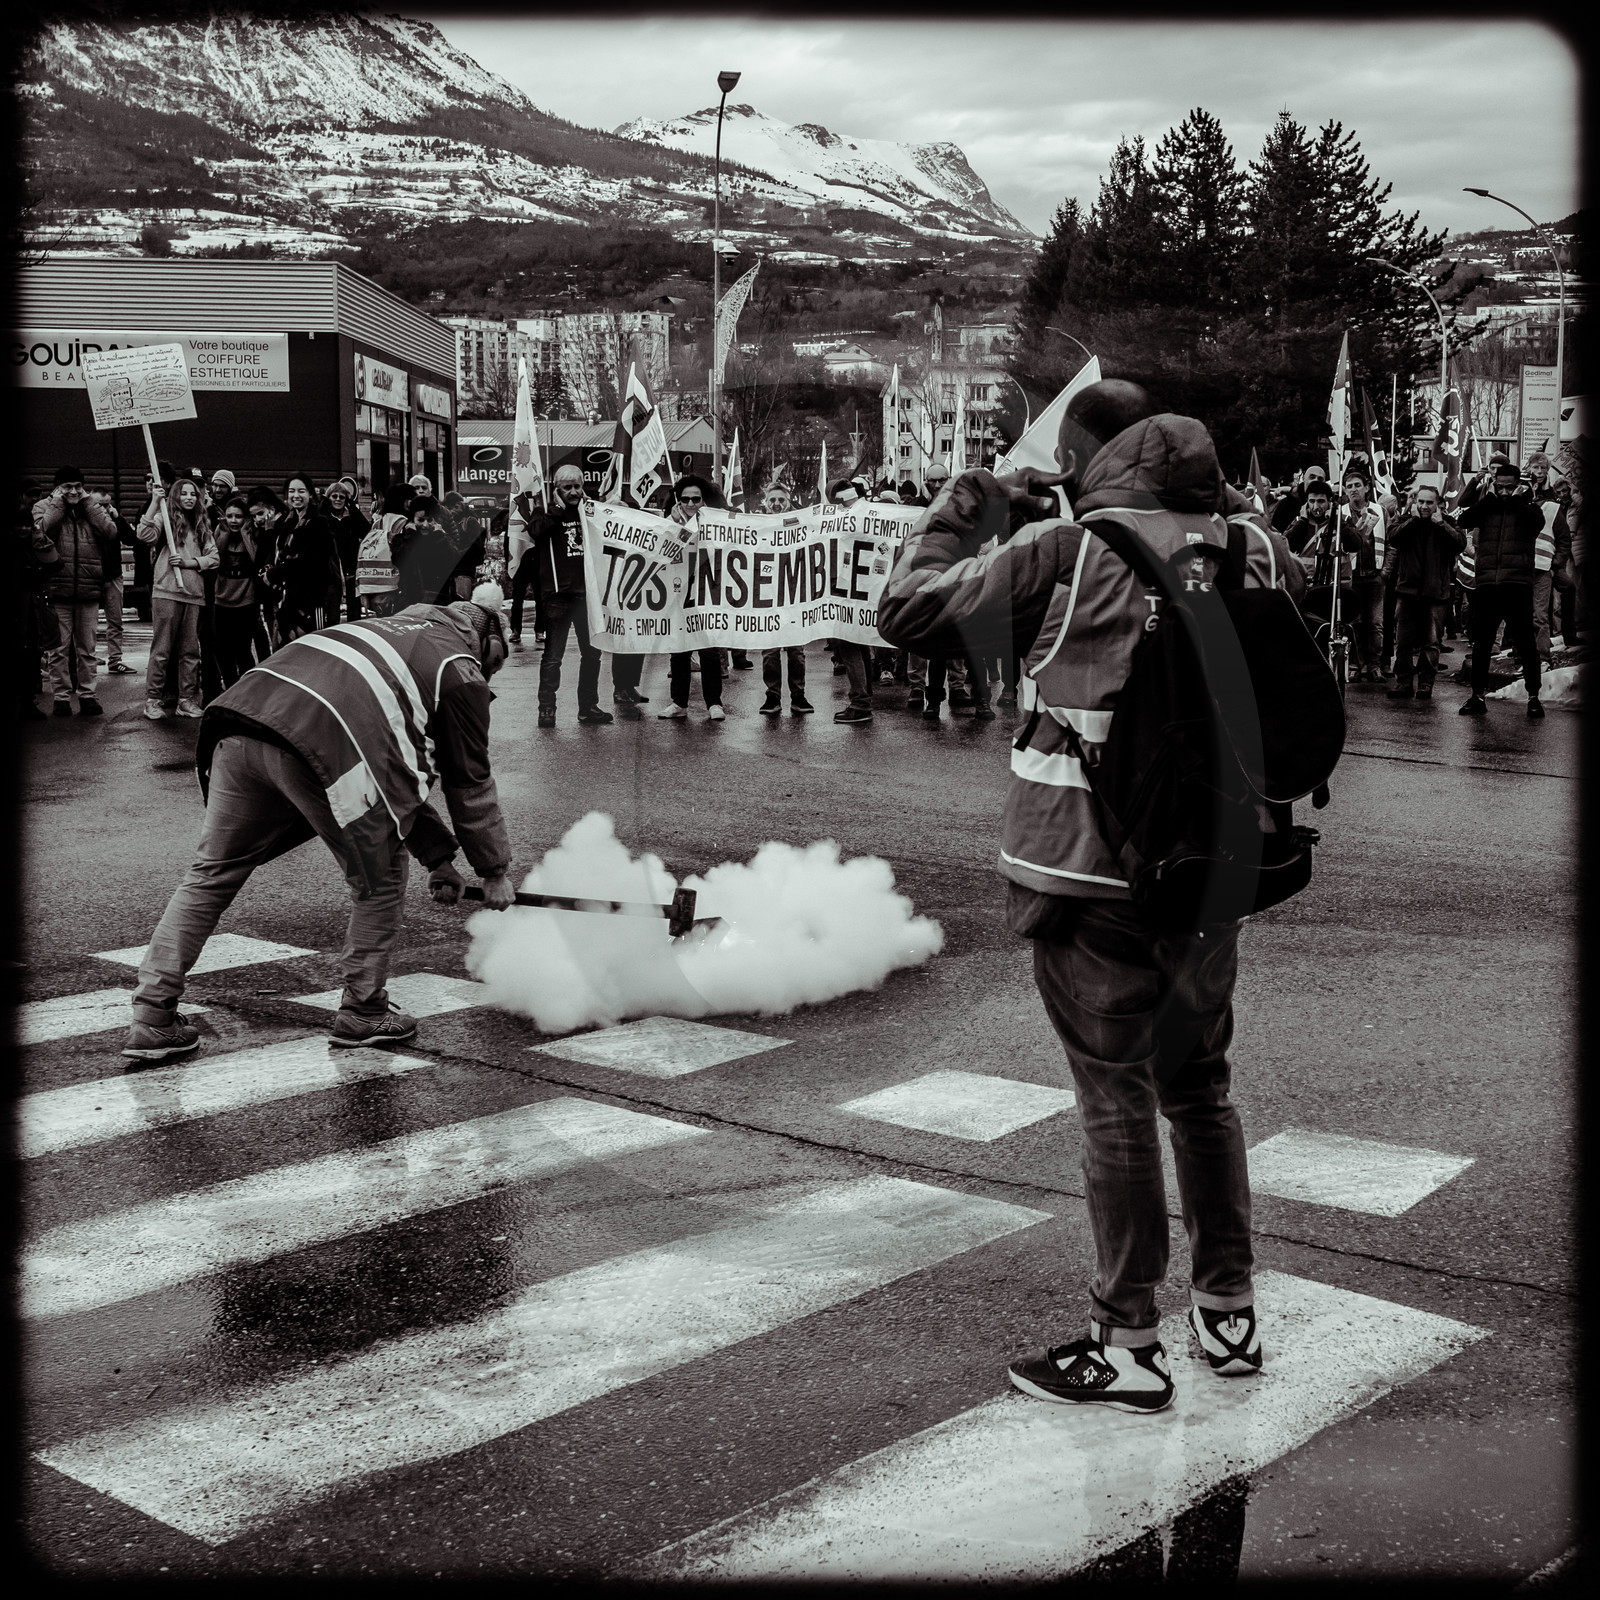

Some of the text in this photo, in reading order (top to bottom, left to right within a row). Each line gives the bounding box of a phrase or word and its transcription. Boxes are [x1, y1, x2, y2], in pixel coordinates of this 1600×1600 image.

[189, 340, 269, 352] Votre boutique
[198, 354, 261, 365] COIFFURE
[190, 368, 269, 380] ESTHETIQUE
[190, 380, 231, 388] ESSIONNELS
[699, 524, 758, 546] RETRAITÉS
[771, 526, 807, 547] JEUNES
[820, 512, 857, 535] PRIVÉS
[863, 516, 913, 540] D'EMPLO
[603, 520, 658, 552] SALARIÉS
[636, 618, 671, 636] EMPLOI
[686, 613, 729, 633] SERVICES
[735, 614, 781, 633] PUBLICS
[801, 602, 854, 628] PROTECTION
[858, 609, 879, 628] SOC
